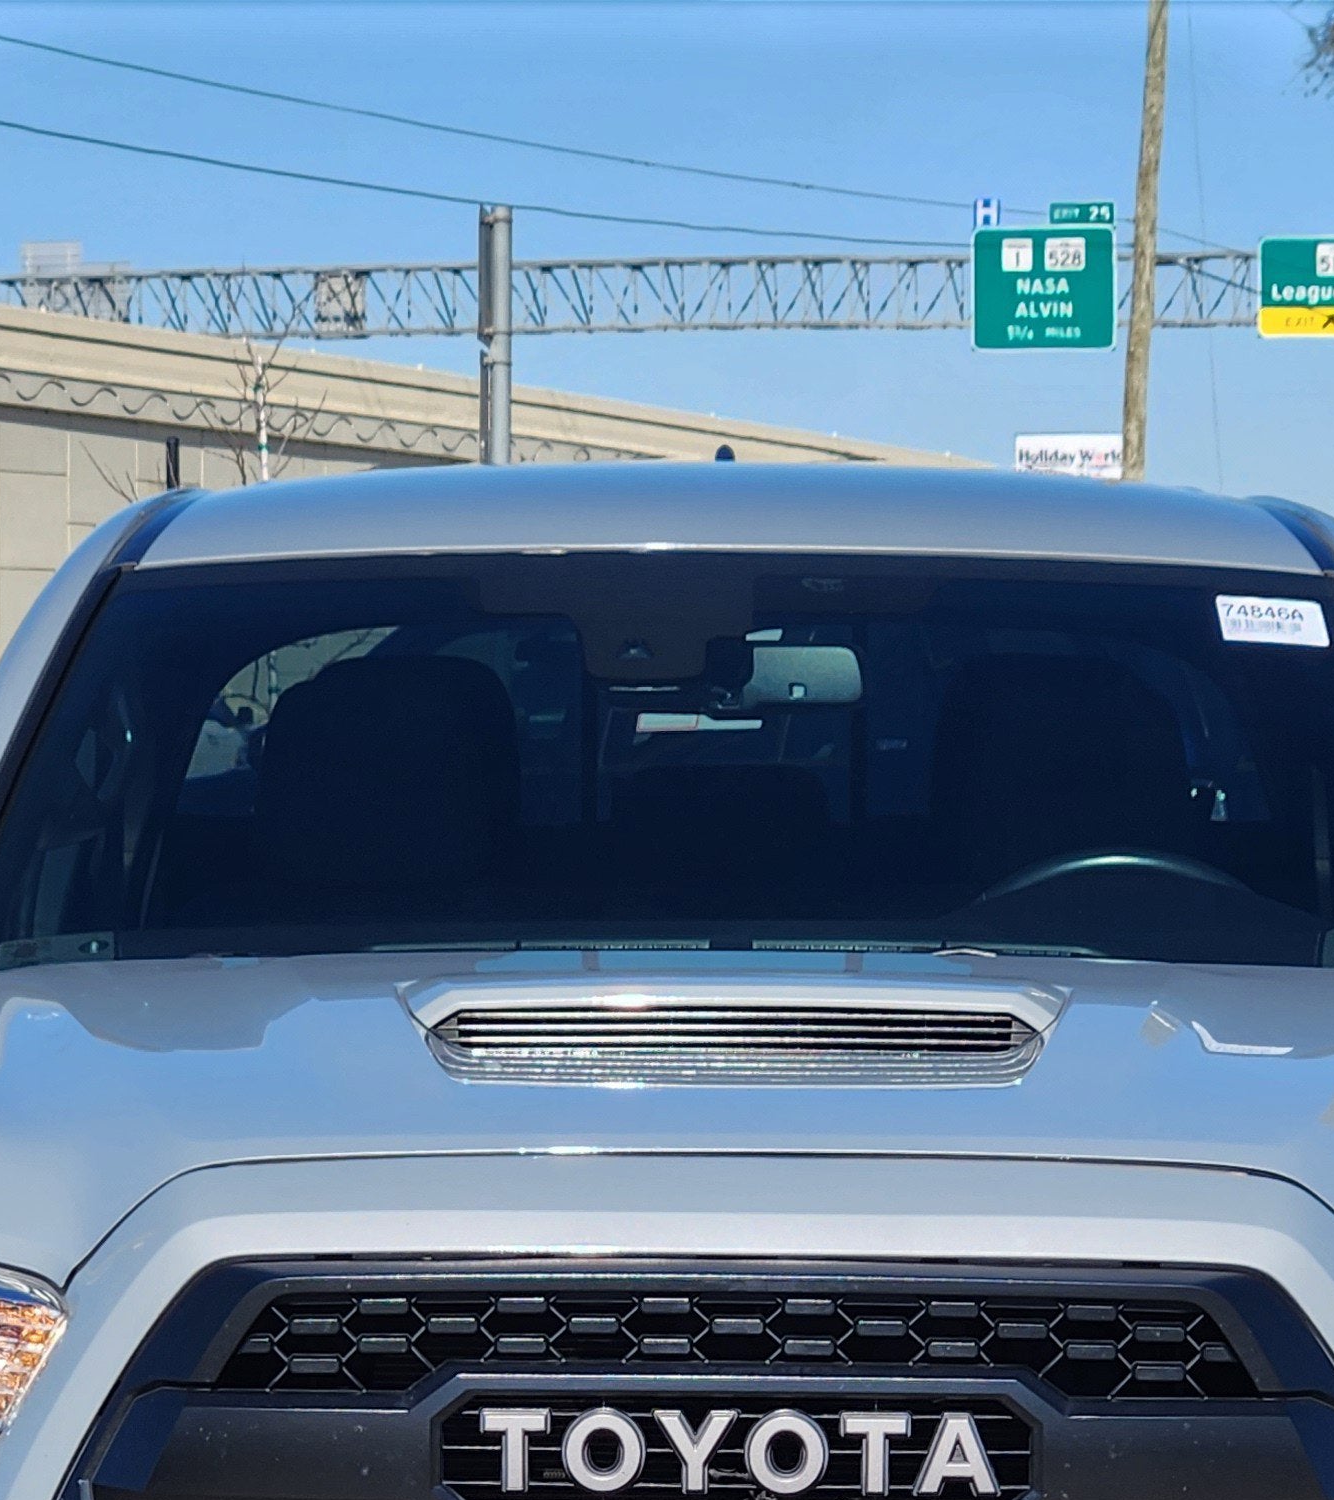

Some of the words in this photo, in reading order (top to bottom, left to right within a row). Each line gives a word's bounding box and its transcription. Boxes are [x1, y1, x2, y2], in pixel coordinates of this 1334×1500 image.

[1048, 249, 1082, 267] 528
[1016, 277, 1070, 295] NASA
[1014, 300, 1074, 319] ALVIN
[1044, 326, 1082, 339] MILES
[1018, 448, 1075, 464] Holiday
[480, 1406, 1001, 1496] TOYOTA
